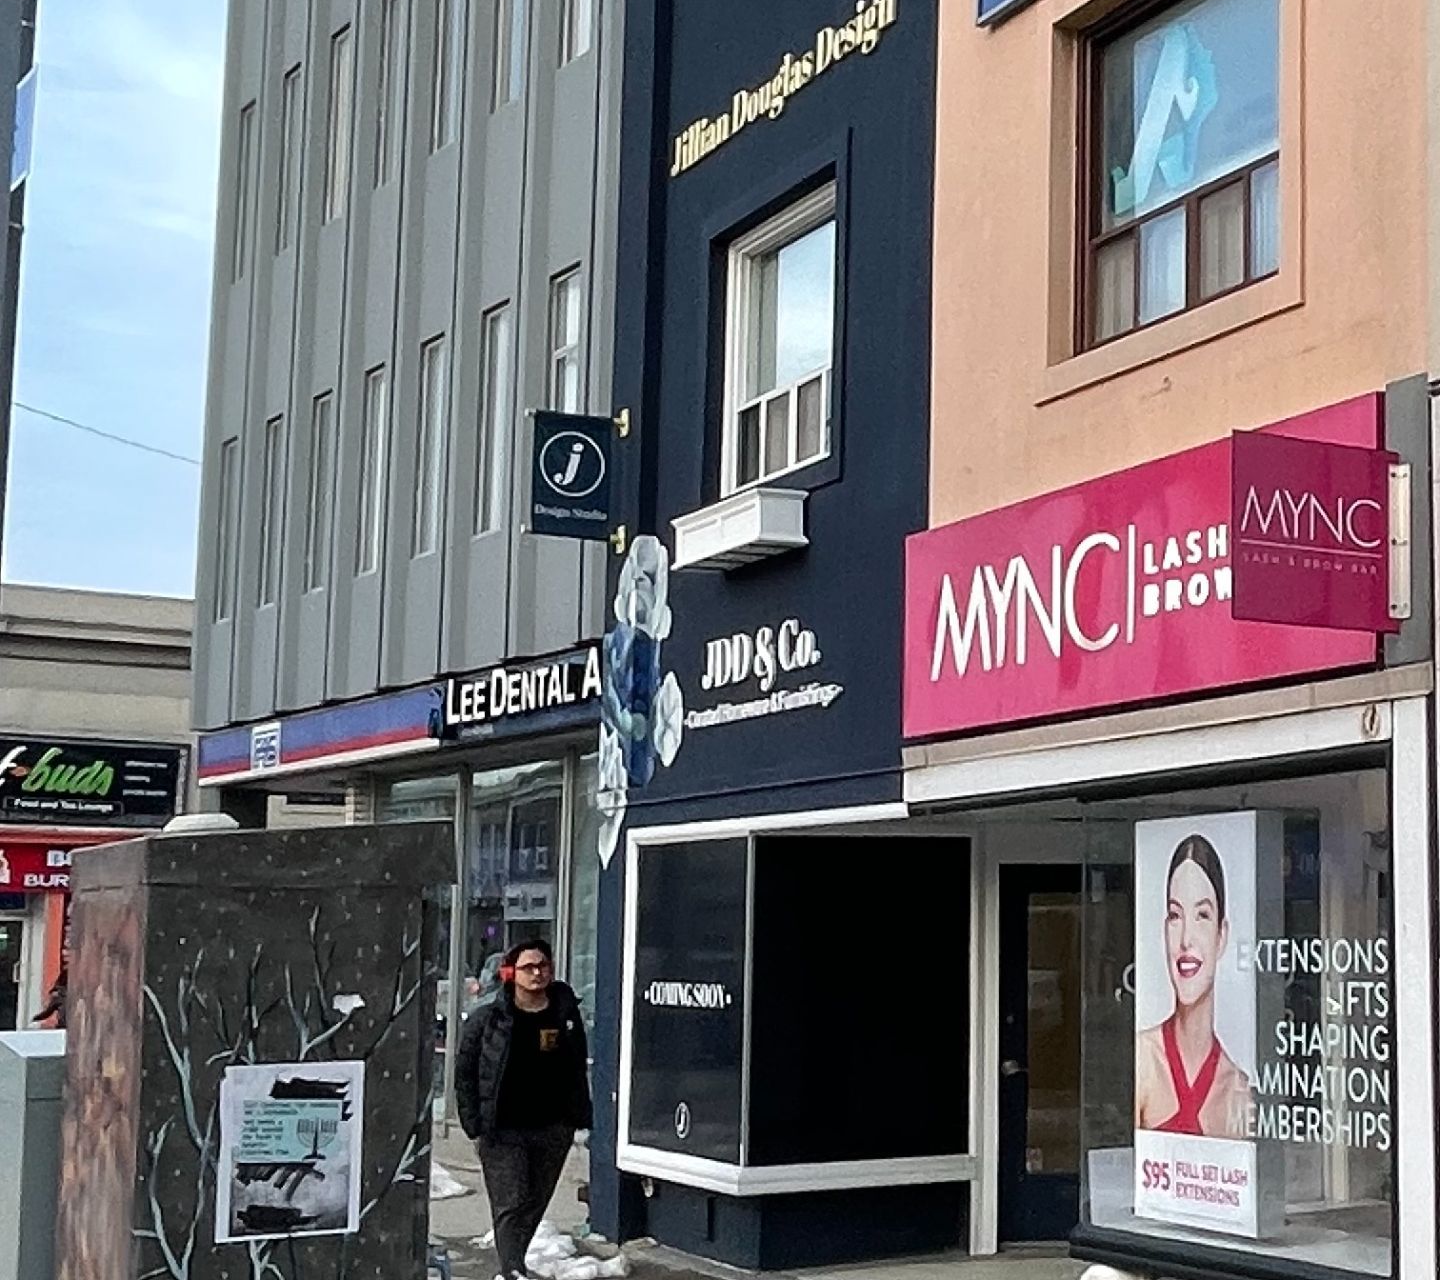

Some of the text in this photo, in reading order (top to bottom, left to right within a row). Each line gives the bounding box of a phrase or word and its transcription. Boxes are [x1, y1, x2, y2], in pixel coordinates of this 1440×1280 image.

[670, 112, 731, 177] Jillian
[731, 51, 815, 135] Douglas
[1240, 485, 1382, 549] MYNC
[1142, 523, 1229, 576] LASH
[930, 531, 1122, 682] MYNC
[701, 618, 822, 692] JDD & Co.
[446, 678, 487, 725] LEE
[489, 662, 576, 717] DENTAL
[1275, 1020, 1391, 1062] SHAPING
[1226, 1102, 1392, 1152] MEMBERSHIPS
[1141, 1158, 1172, 1192] $95
[1175, 1161, 1200, 1179] FULL
[1220, 1166, 1249, 1187] LASH
[1175, 1181, 1241, 1208] EXTENSIONS
